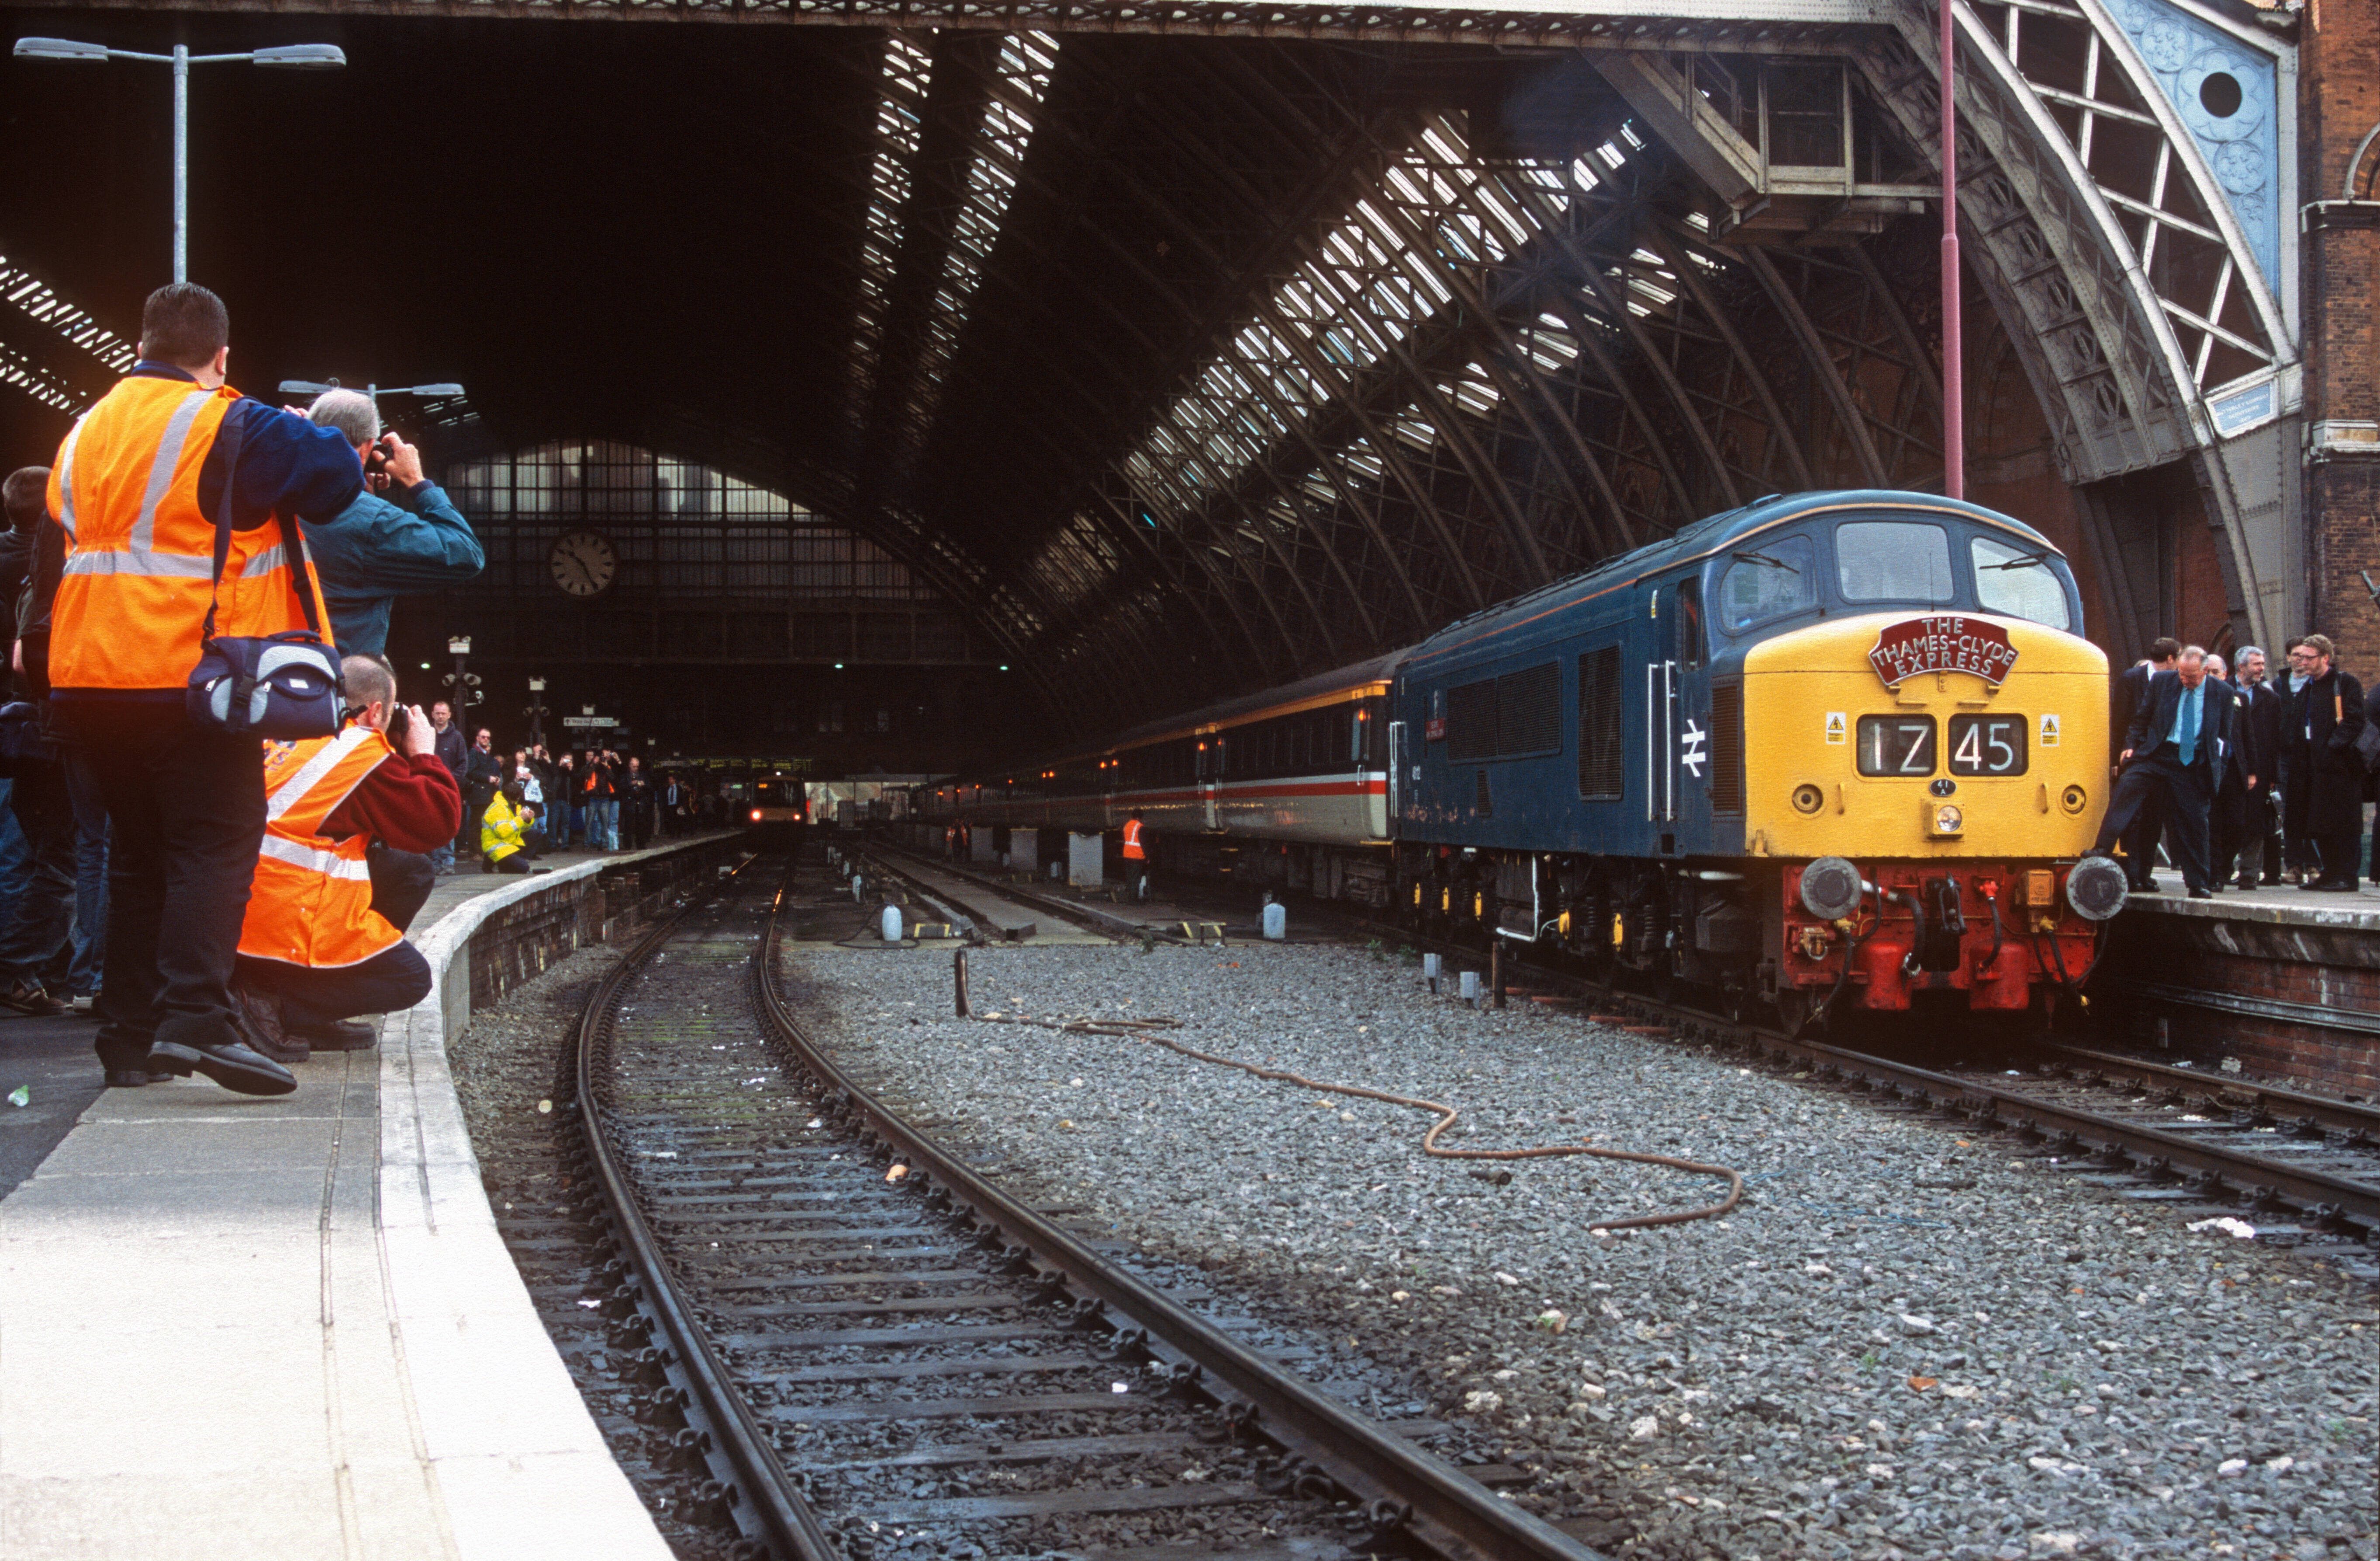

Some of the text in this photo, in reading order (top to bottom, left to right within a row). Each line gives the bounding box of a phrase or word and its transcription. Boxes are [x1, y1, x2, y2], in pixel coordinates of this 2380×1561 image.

[1922, 618, 1964, 634] THE
[1872, 635, 2016, 666] THAMES-CLYDE
[1894, 651, 1994, 676] EXPRESS
[1955, 723, 2014, 771] 45
[1937, 780, 1948, 788] 41
